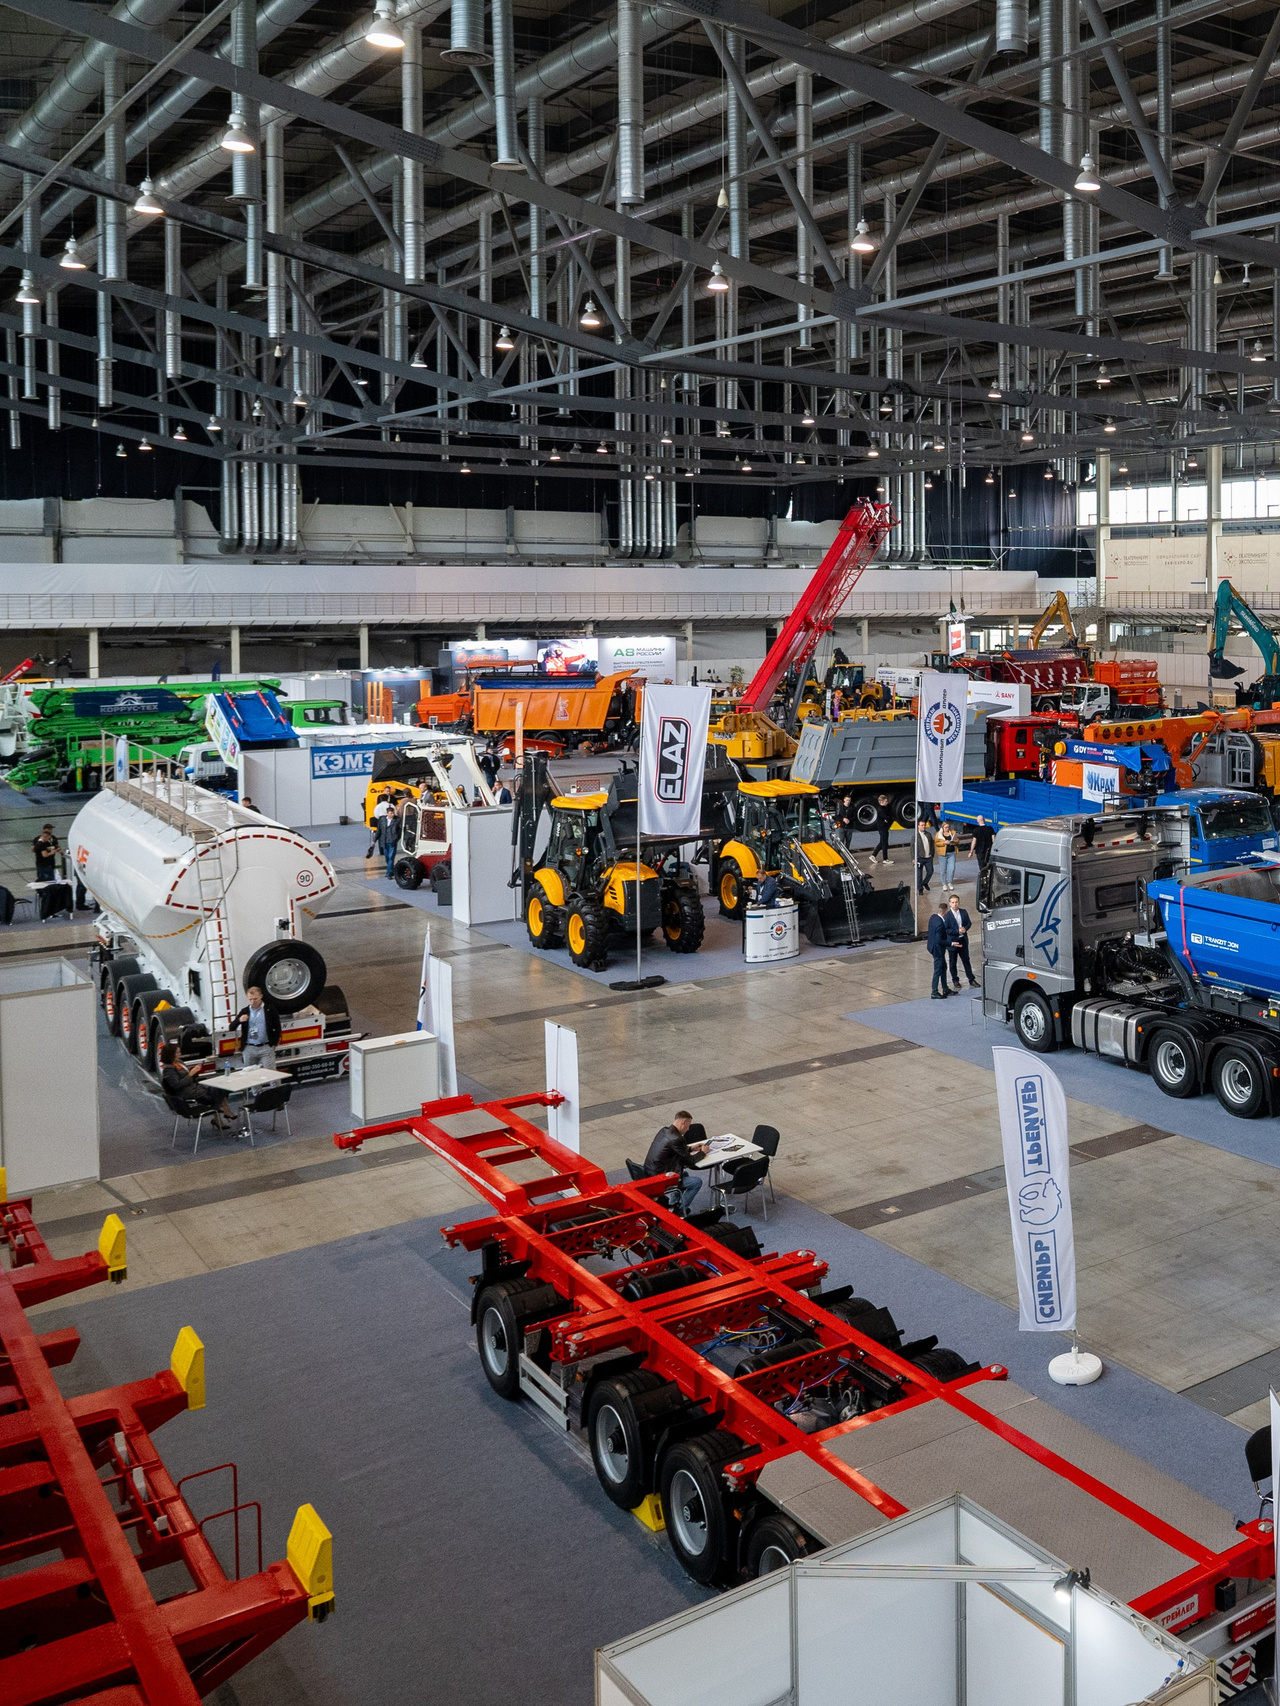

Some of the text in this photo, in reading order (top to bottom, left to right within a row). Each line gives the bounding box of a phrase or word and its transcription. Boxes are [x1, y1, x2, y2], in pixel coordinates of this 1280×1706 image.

[100, 704, 159, 713] КОРРУС-ТЕХ
[313, 753, 375, 772] КЭМЗ
[660, 721, 687, 799] ELAZ
[299, 874, 311, 883] 90
[1160, 1601, 1195, 1627] ТРЕЙЛЕР
